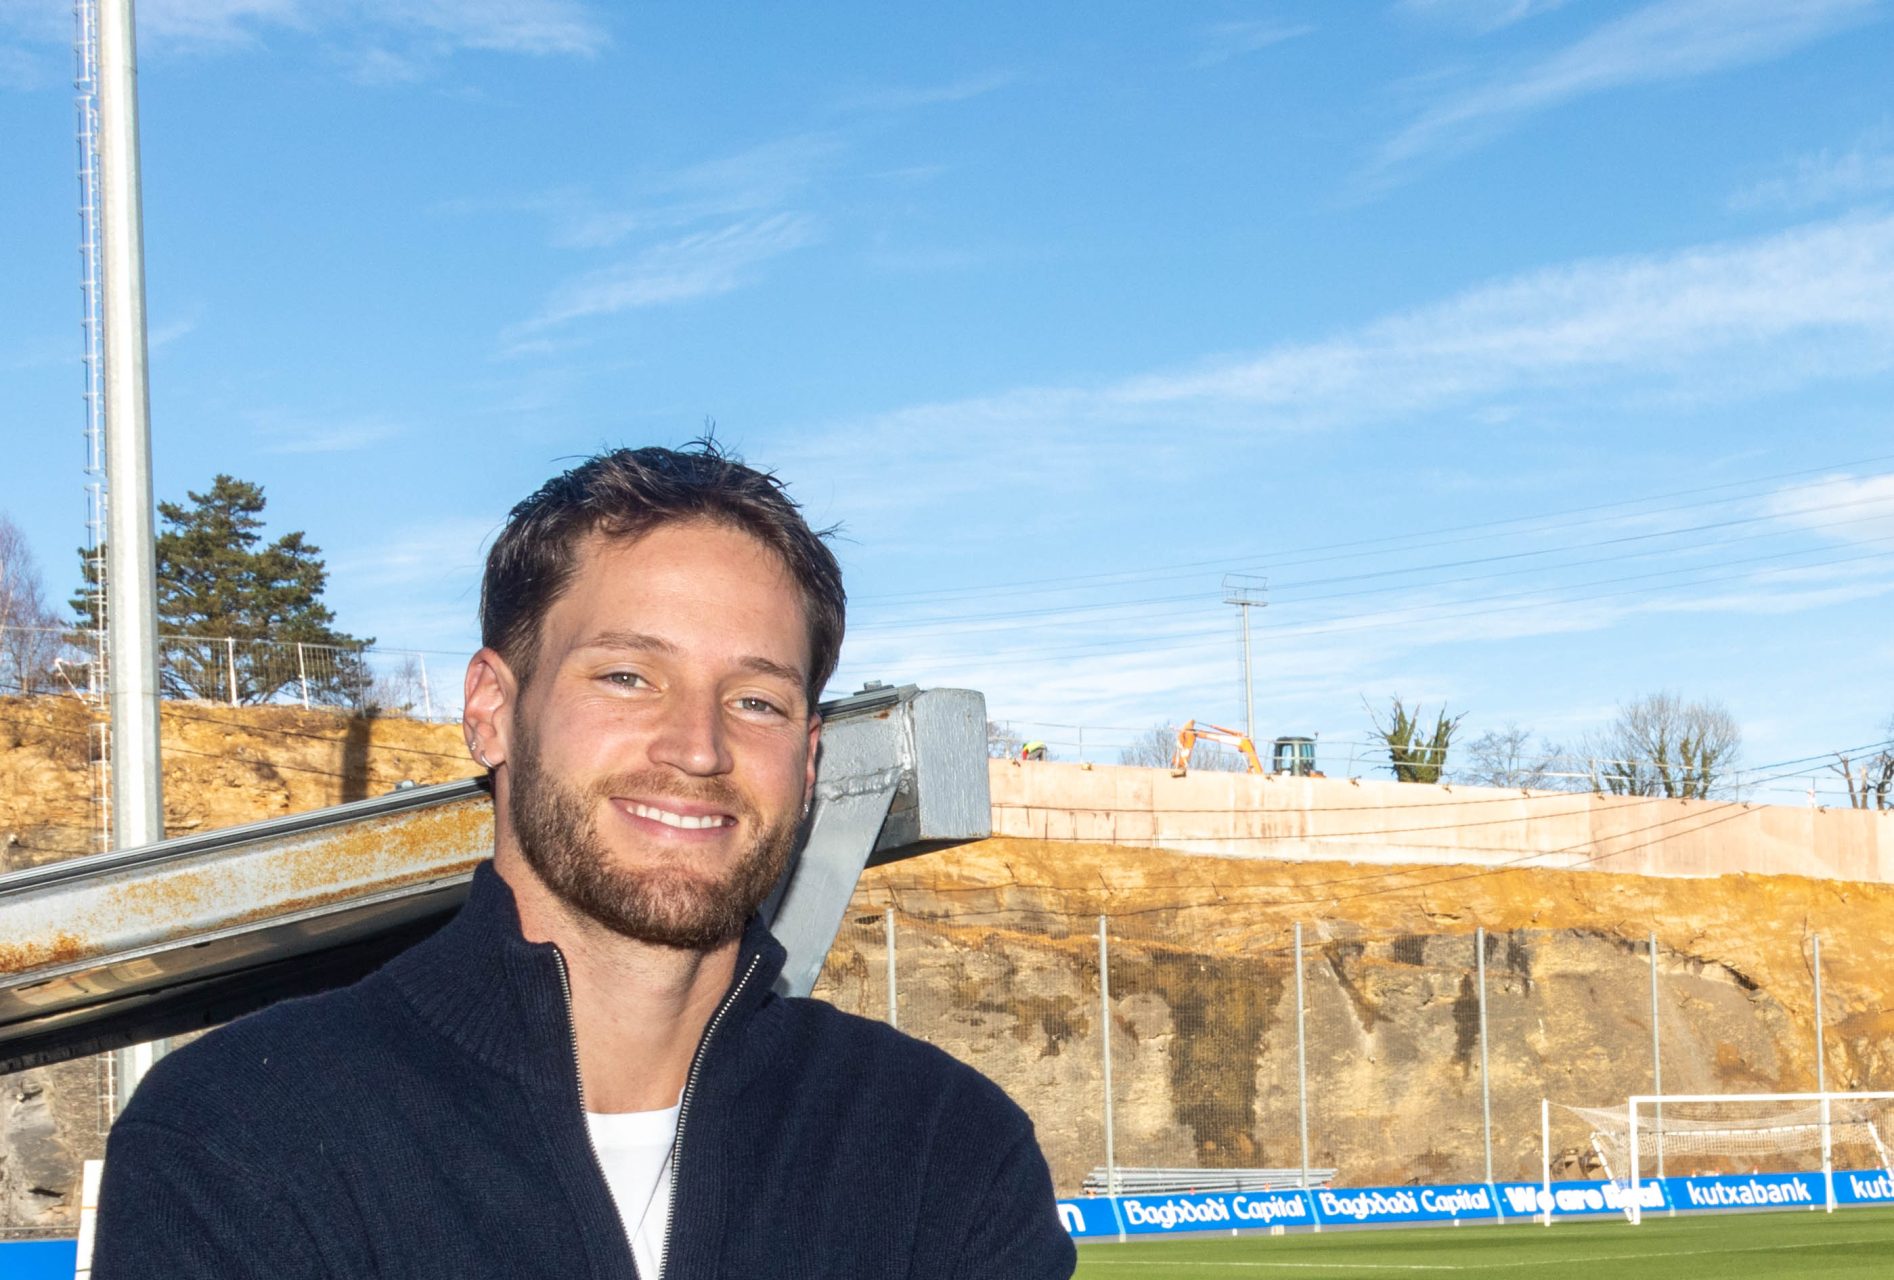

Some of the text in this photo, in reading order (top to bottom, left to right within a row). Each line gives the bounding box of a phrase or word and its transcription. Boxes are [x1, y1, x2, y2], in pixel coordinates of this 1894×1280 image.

[1318, 1187, 1490, 1220] Baghdadi Capital
[1556, 1189, 1603, 1210] are
[1686, 1177, 1812, 1205] kutxabank
[1123, 1194, 1306, 1229] Baghdadi Capital
